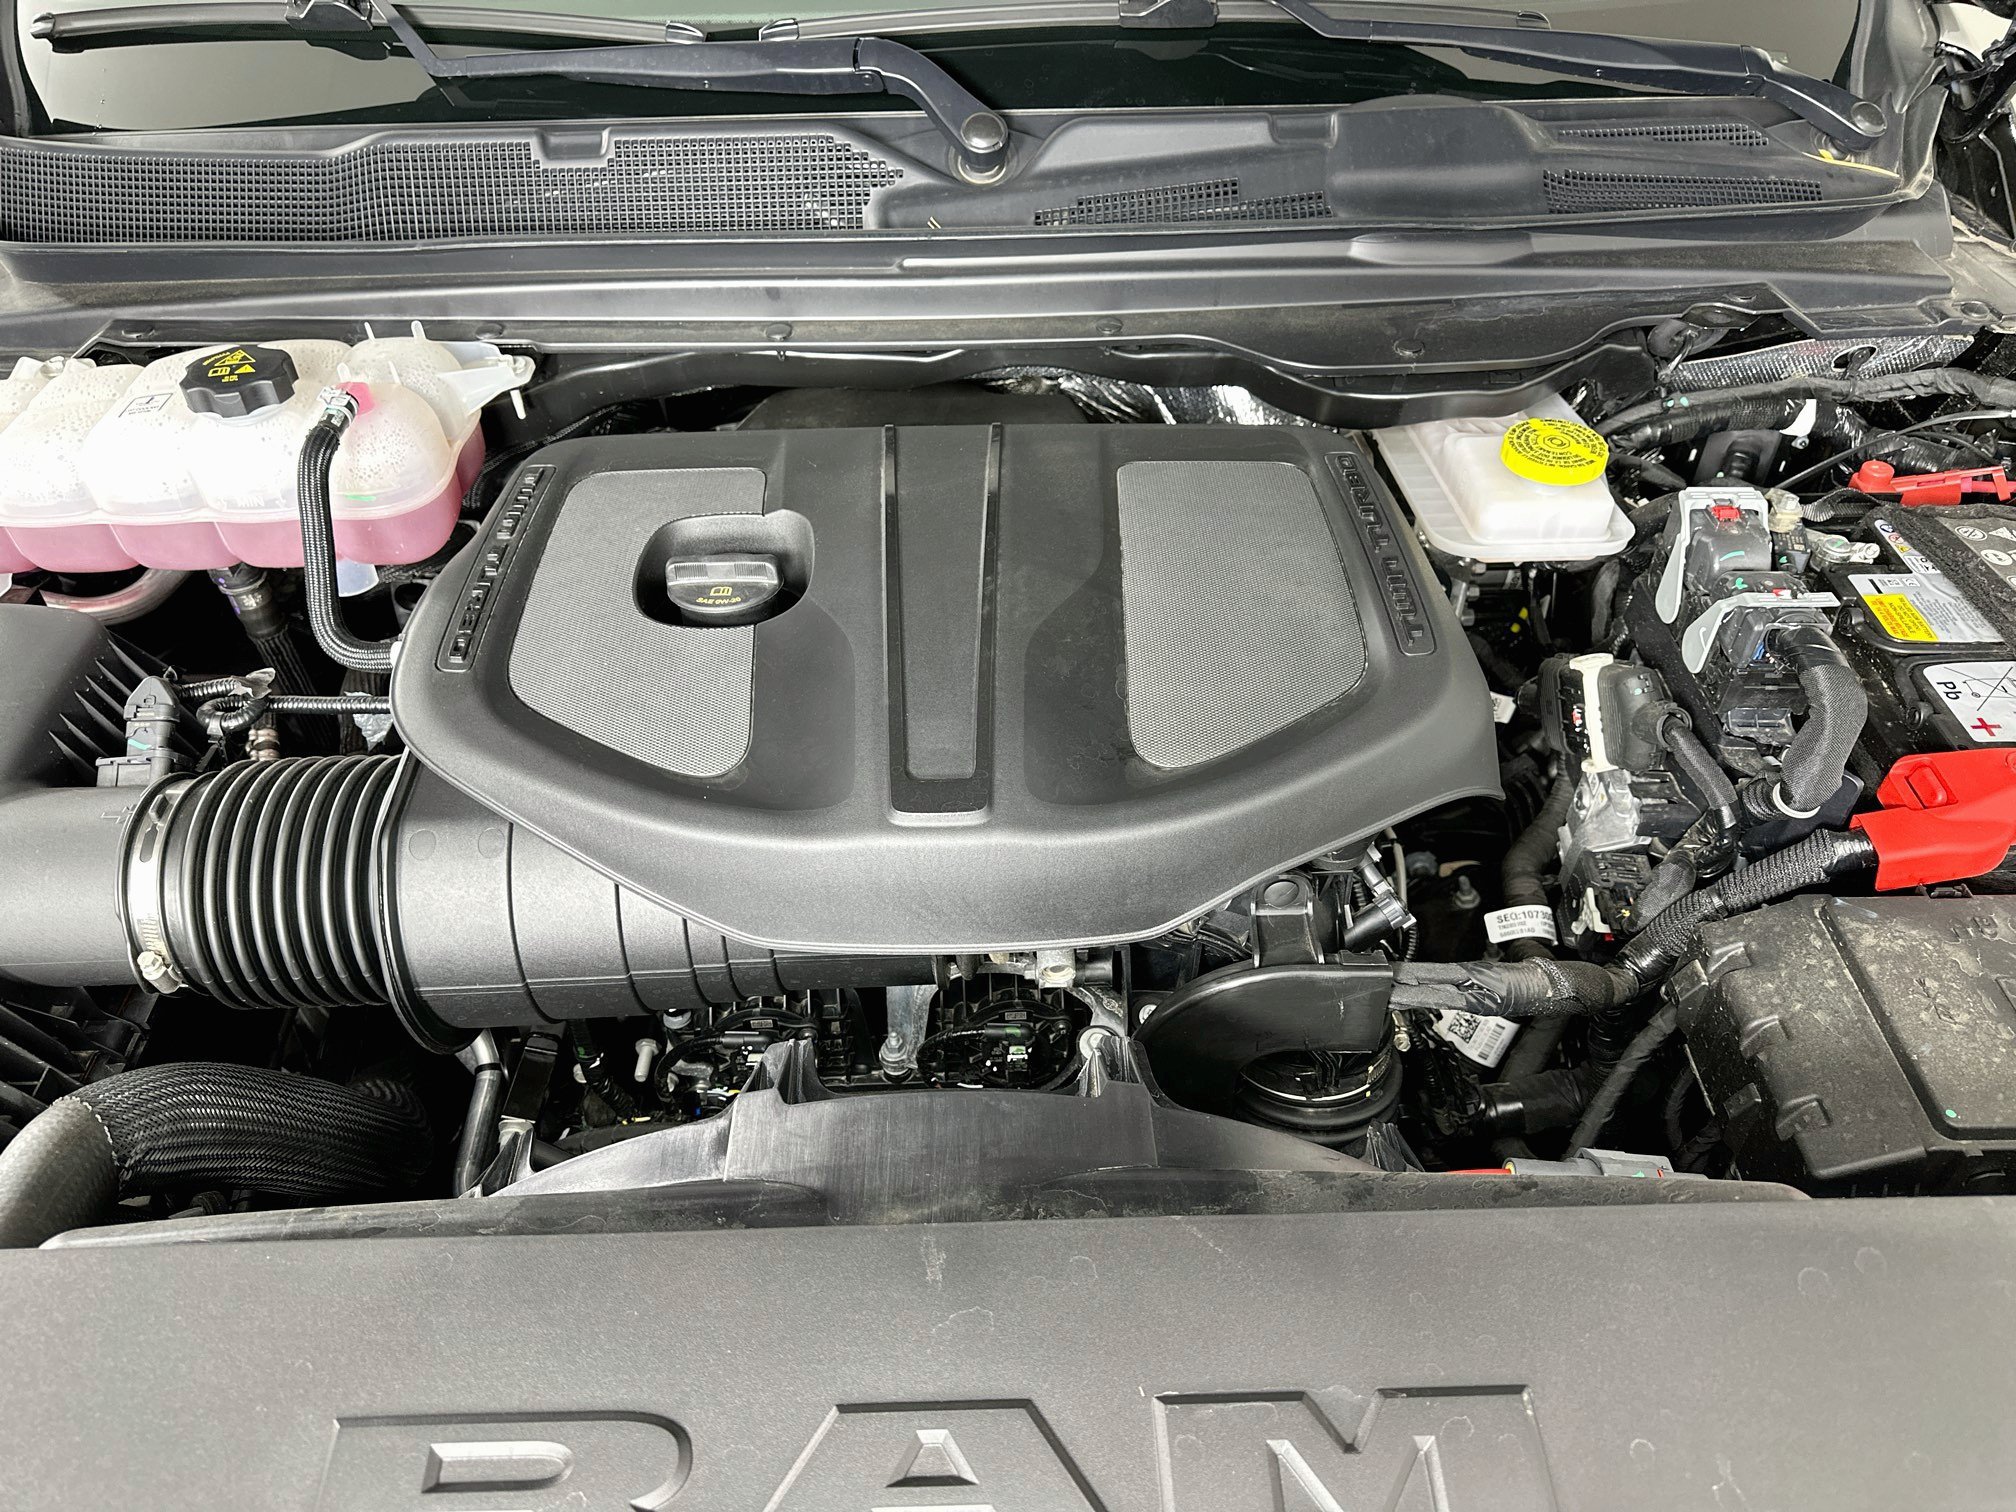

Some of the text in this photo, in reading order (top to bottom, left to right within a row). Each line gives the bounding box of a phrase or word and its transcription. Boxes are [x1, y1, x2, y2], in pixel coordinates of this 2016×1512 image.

[238, 495, 265, 510] MIN
[1335, 454, 1390, 554] TURBO
[448, 542, 510, 664] TURBO
[695, 596, 742, 605] SAE 0W-20
[1936, 680, 1963, 701] Pb
